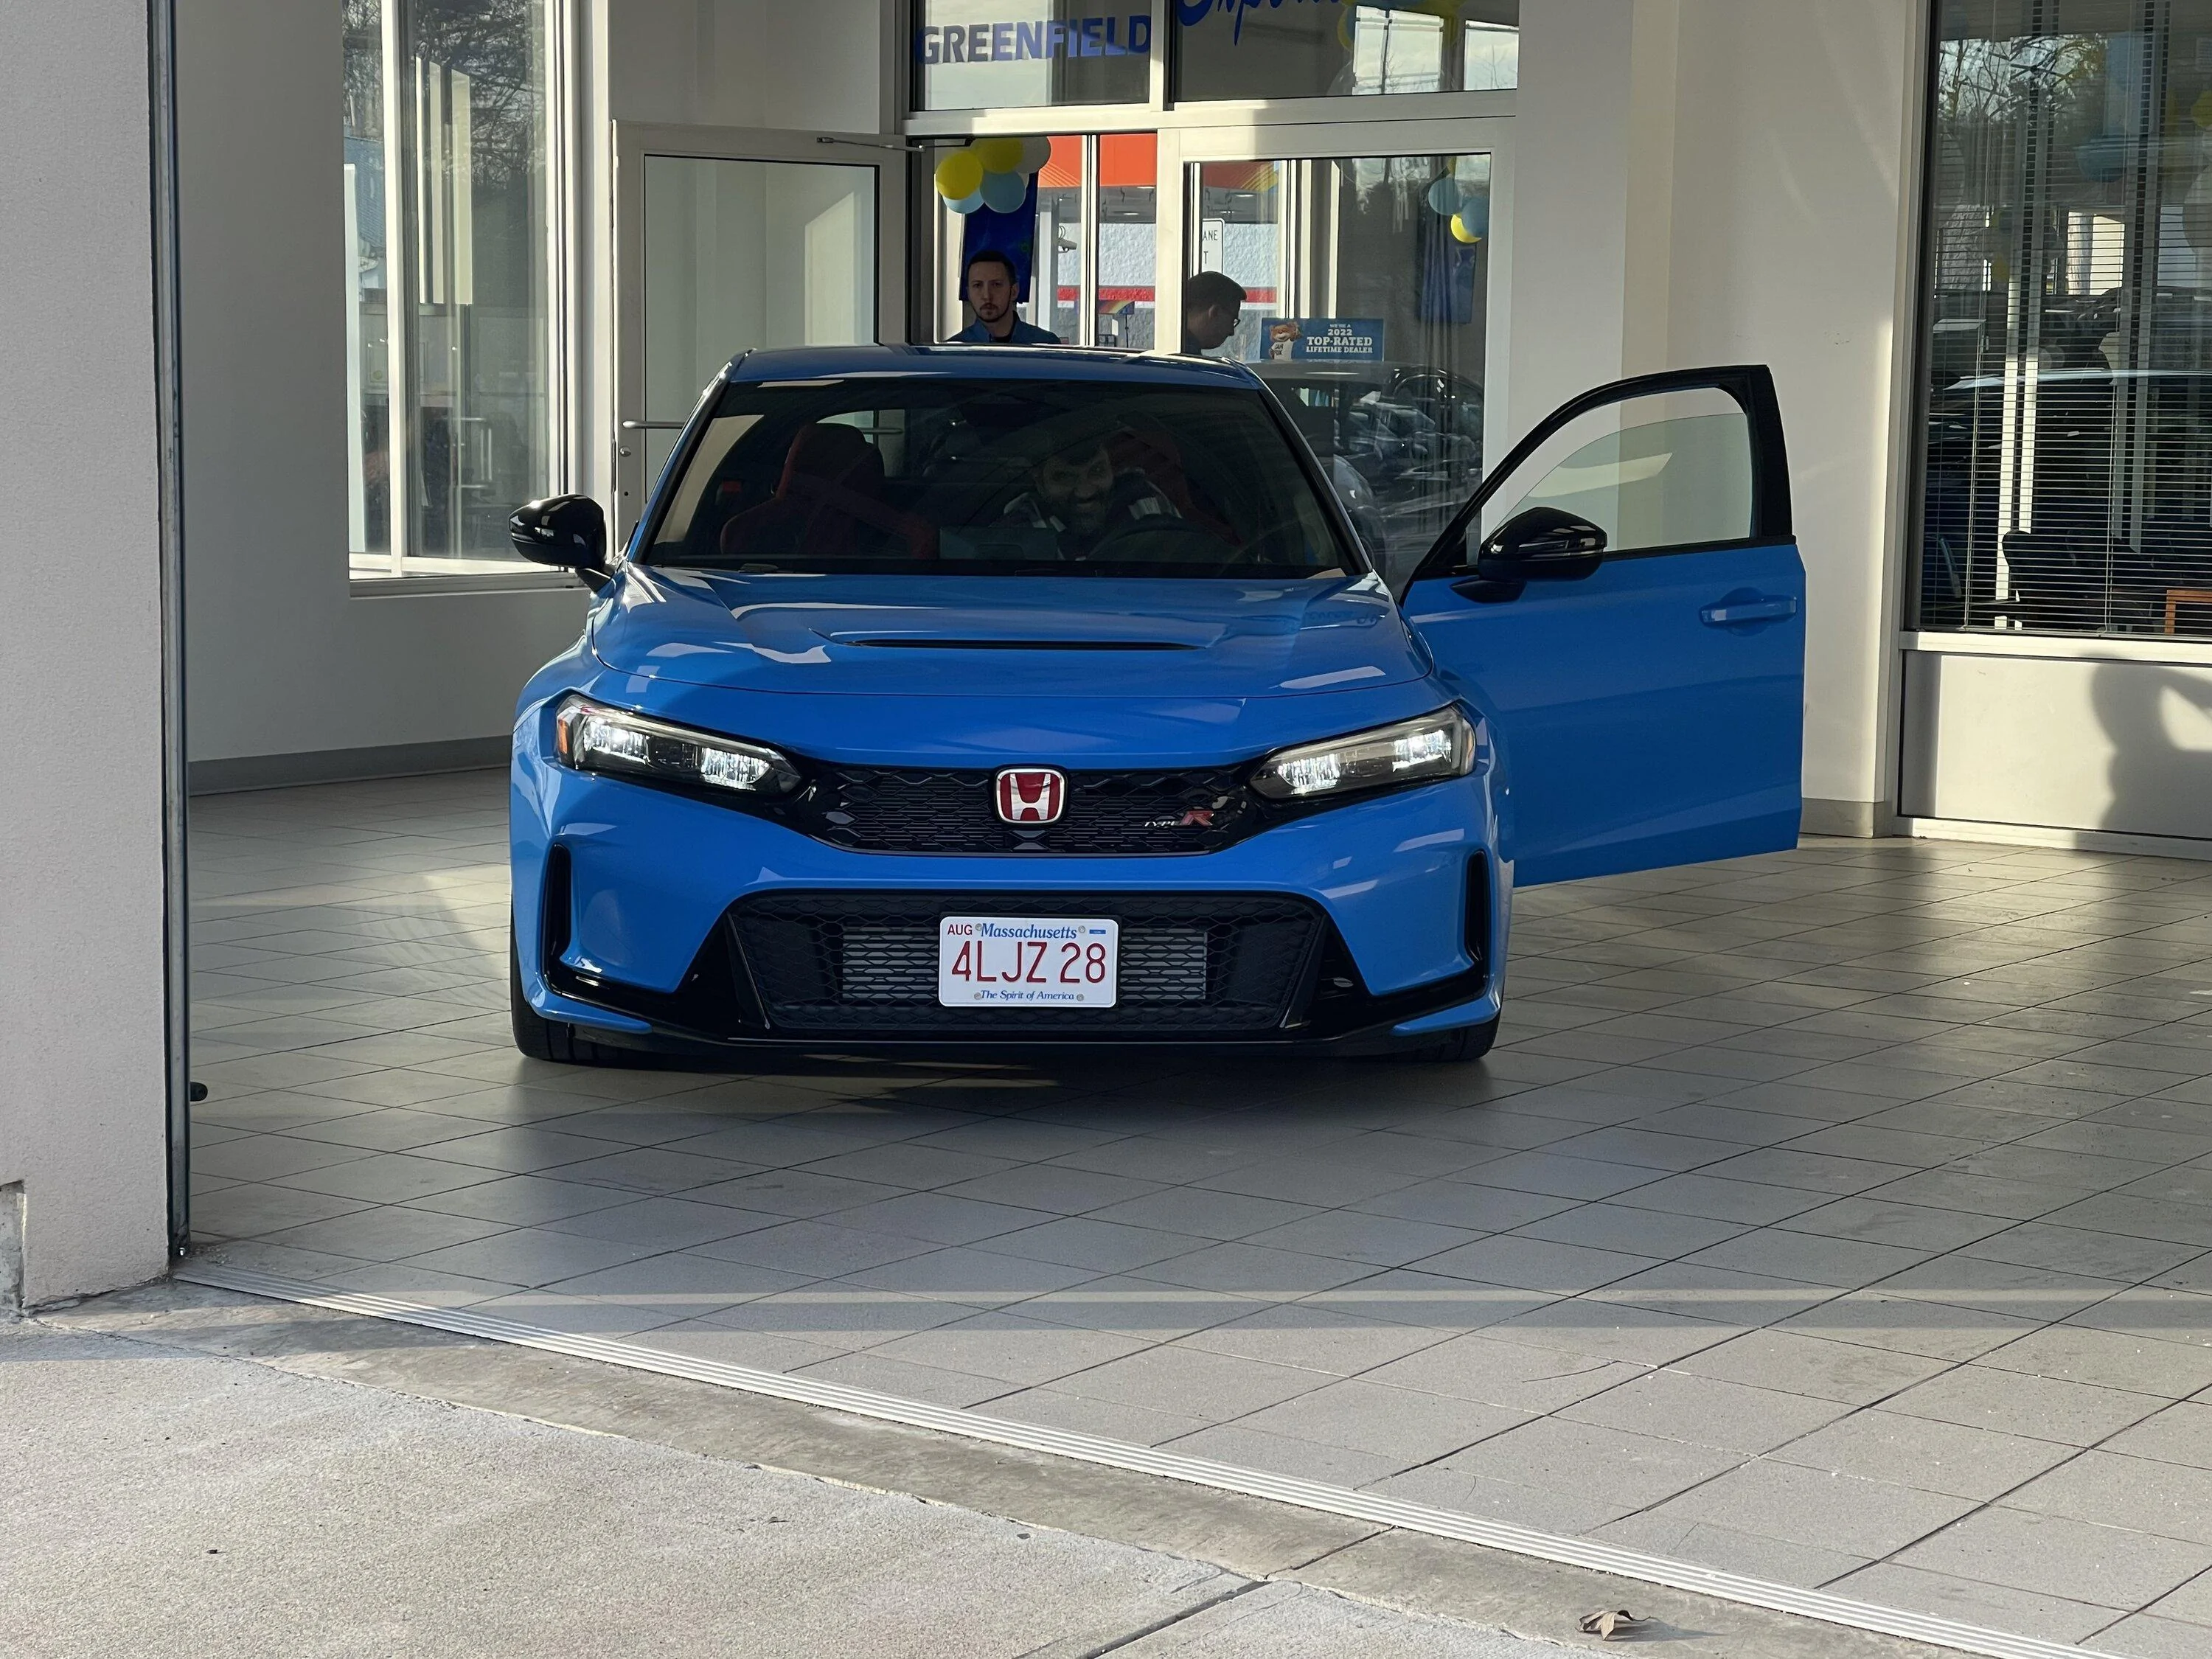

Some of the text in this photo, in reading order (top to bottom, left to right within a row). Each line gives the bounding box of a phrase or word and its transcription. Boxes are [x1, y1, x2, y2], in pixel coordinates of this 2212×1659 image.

[914, 14, 1151, 65] GREENFIELD
[1202, 229, 1218, 241] ANE
[1306, 336, 1373, 347] TOP-RATED
[947, 924, 973, 936] AUG
[981, 923, 1077, 939] Massachusetts
[951, 940, 1106, 984] 4LJZ 28
[981, 990, 1074, 1001] The Spirit of America
